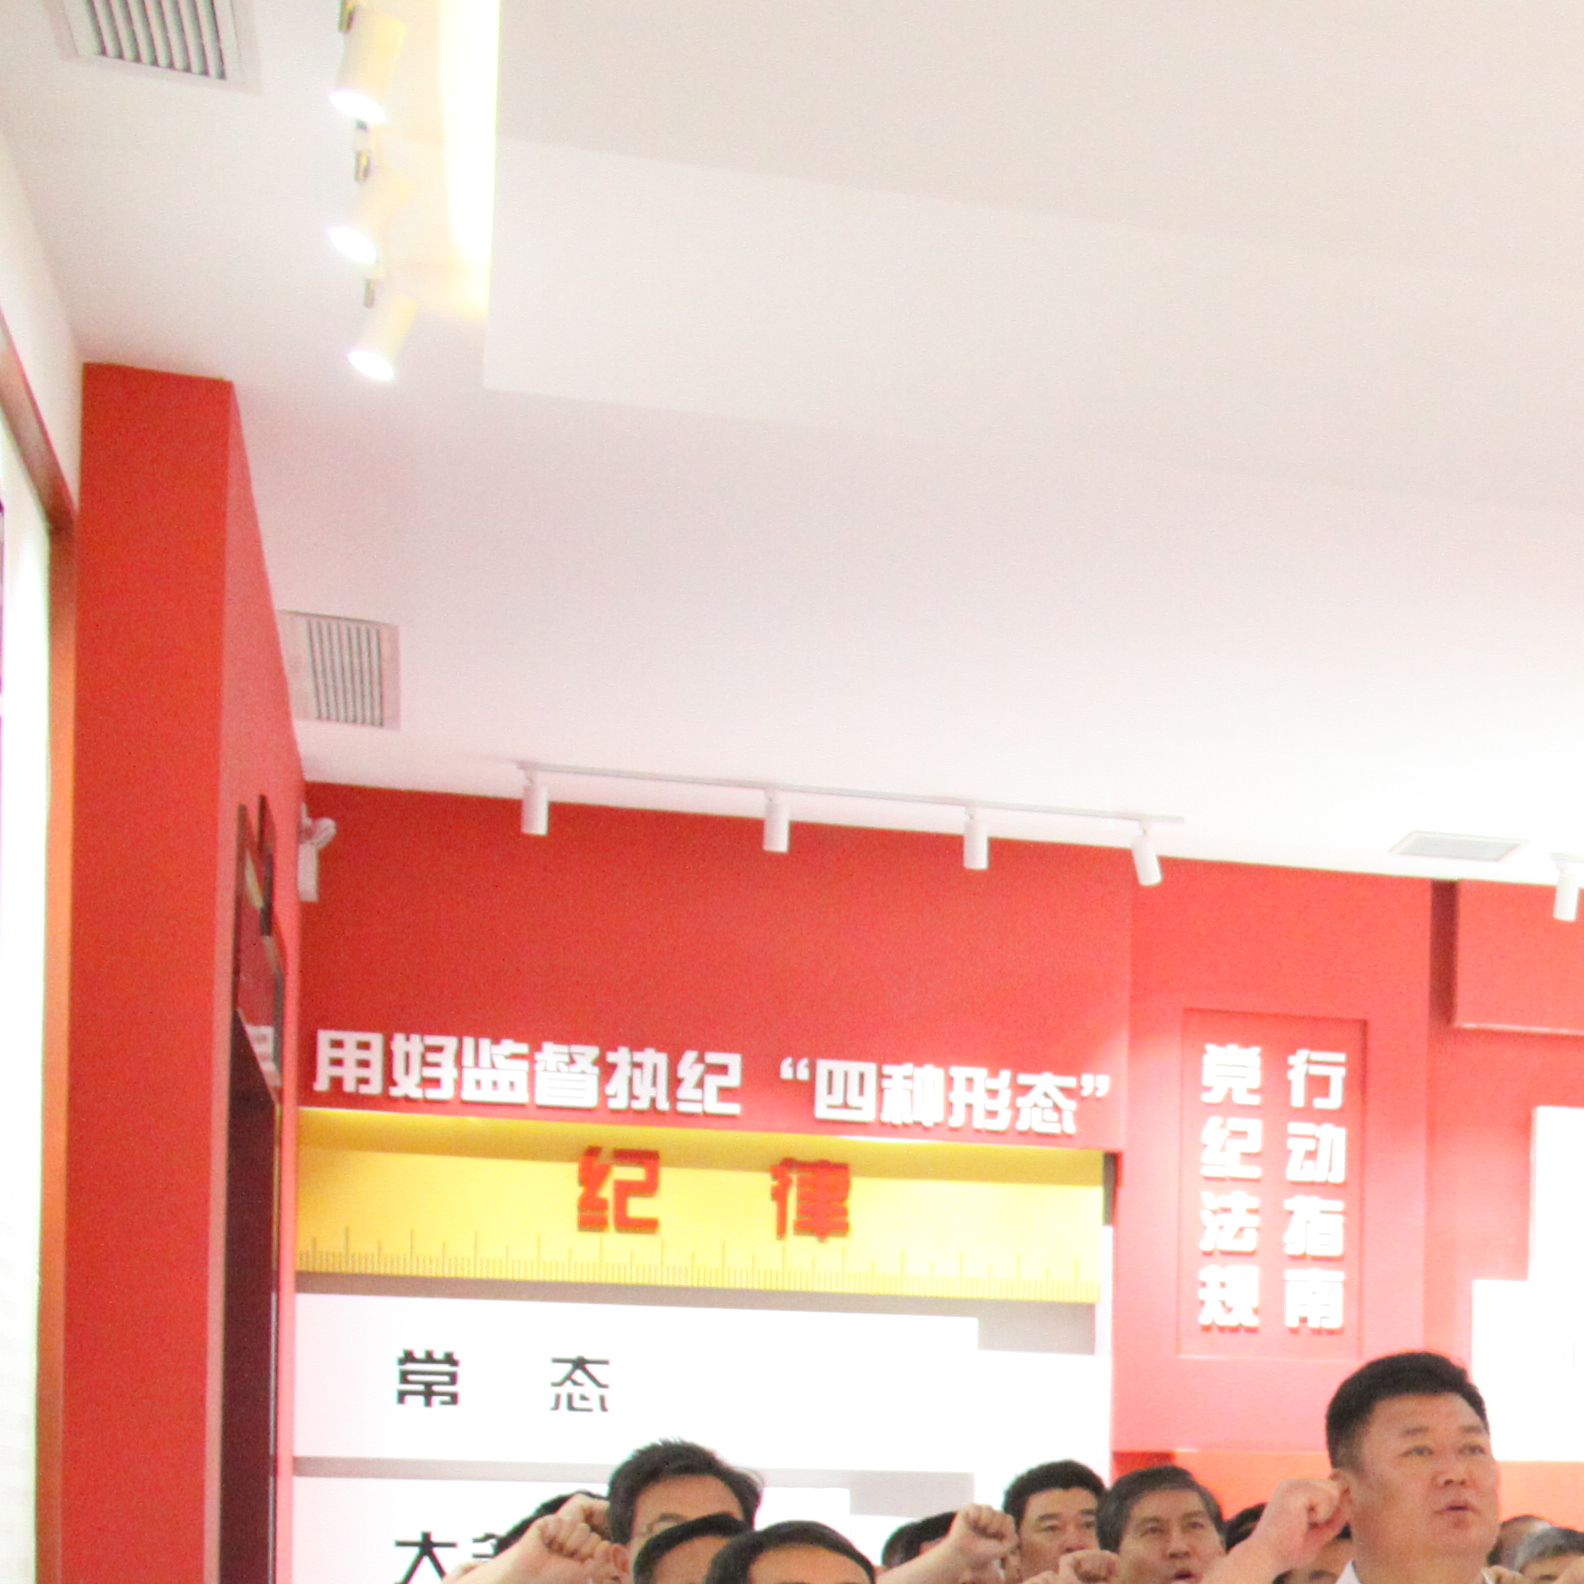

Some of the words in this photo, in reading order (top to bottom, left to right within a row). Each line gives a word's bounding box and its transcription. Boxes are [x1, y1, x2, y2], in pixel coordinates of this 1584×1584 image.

[576, 1145, 850, 1242] 纪律
[1198, 1042, 1264, 1330] 党纪法规
[1283, 1048, 1347, 1332] 行动指南
[396, 1349, 609, 1412] 常态
